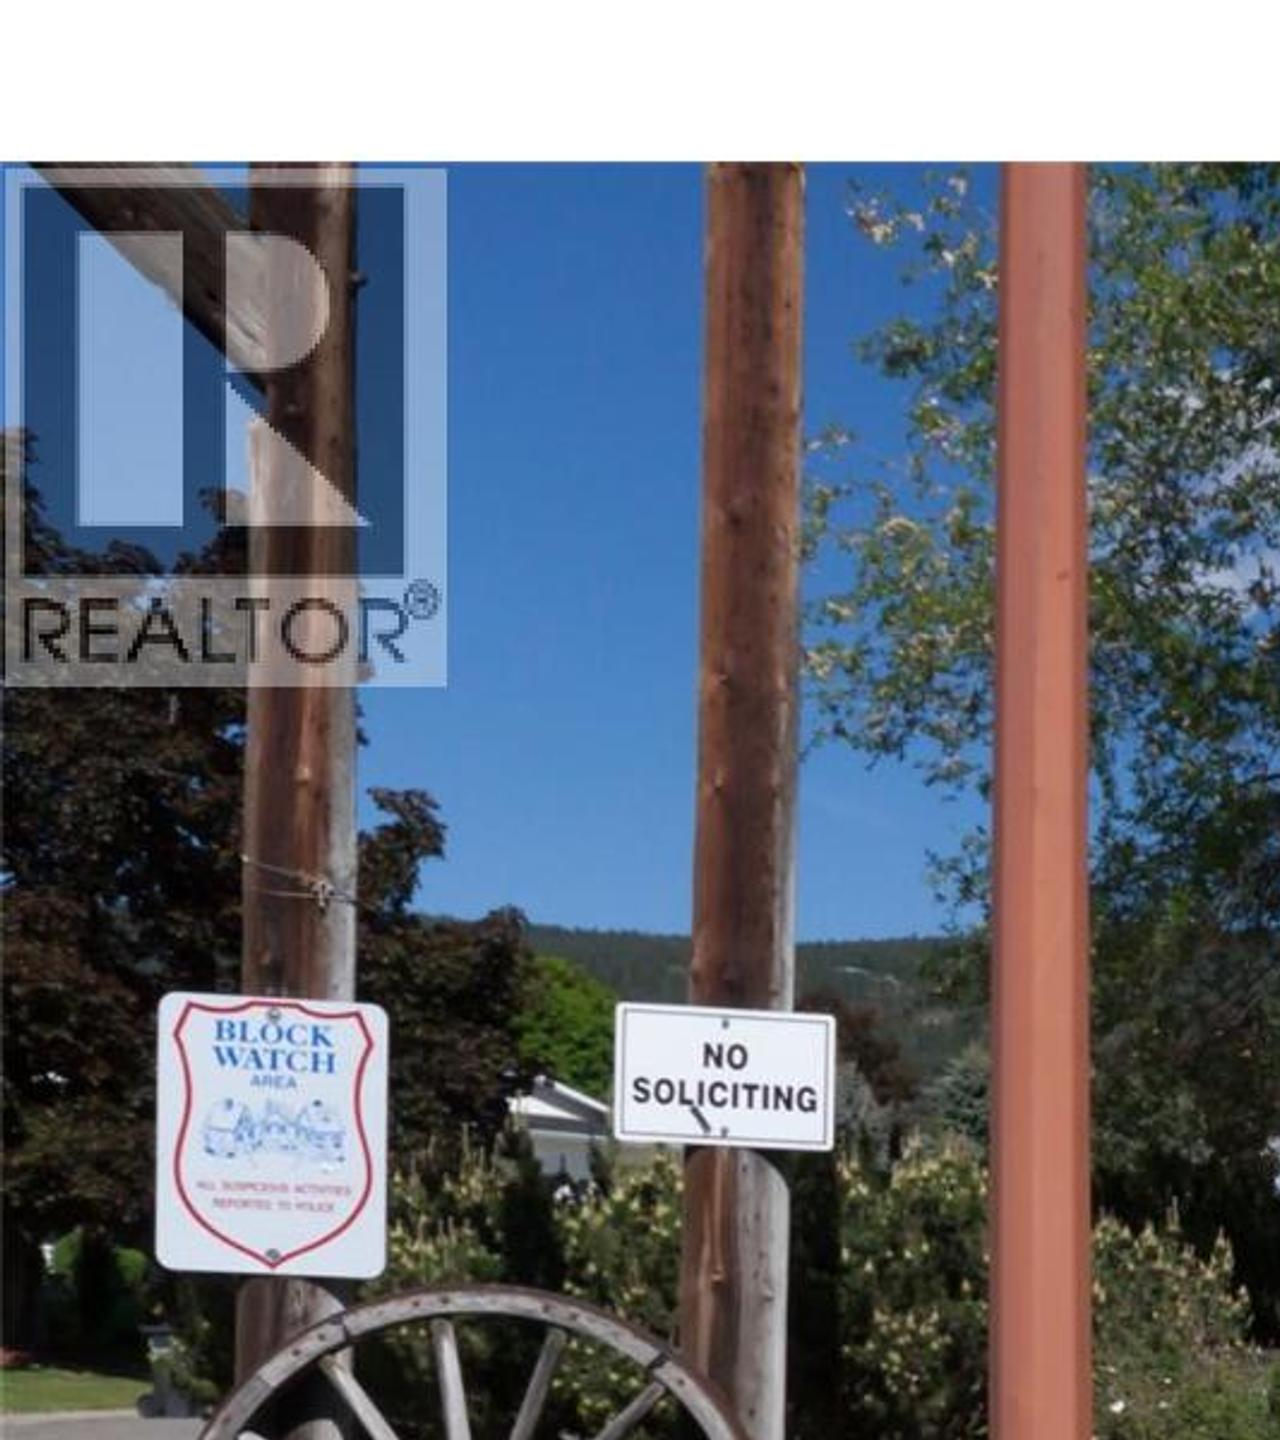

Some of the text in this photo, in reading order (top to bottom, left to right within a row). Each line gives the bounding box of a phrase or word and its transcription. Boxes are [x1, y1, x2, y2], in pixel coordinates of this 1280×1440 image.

[214, 1019, 333, 1048] BLOCK
[212, 1045, 335, 1074] WATCH
[703, 1042, 748, 1070] NO
[250, 1075, 297, 1089] AREA
[632, 1077, 817, 1113] SOLICITING
